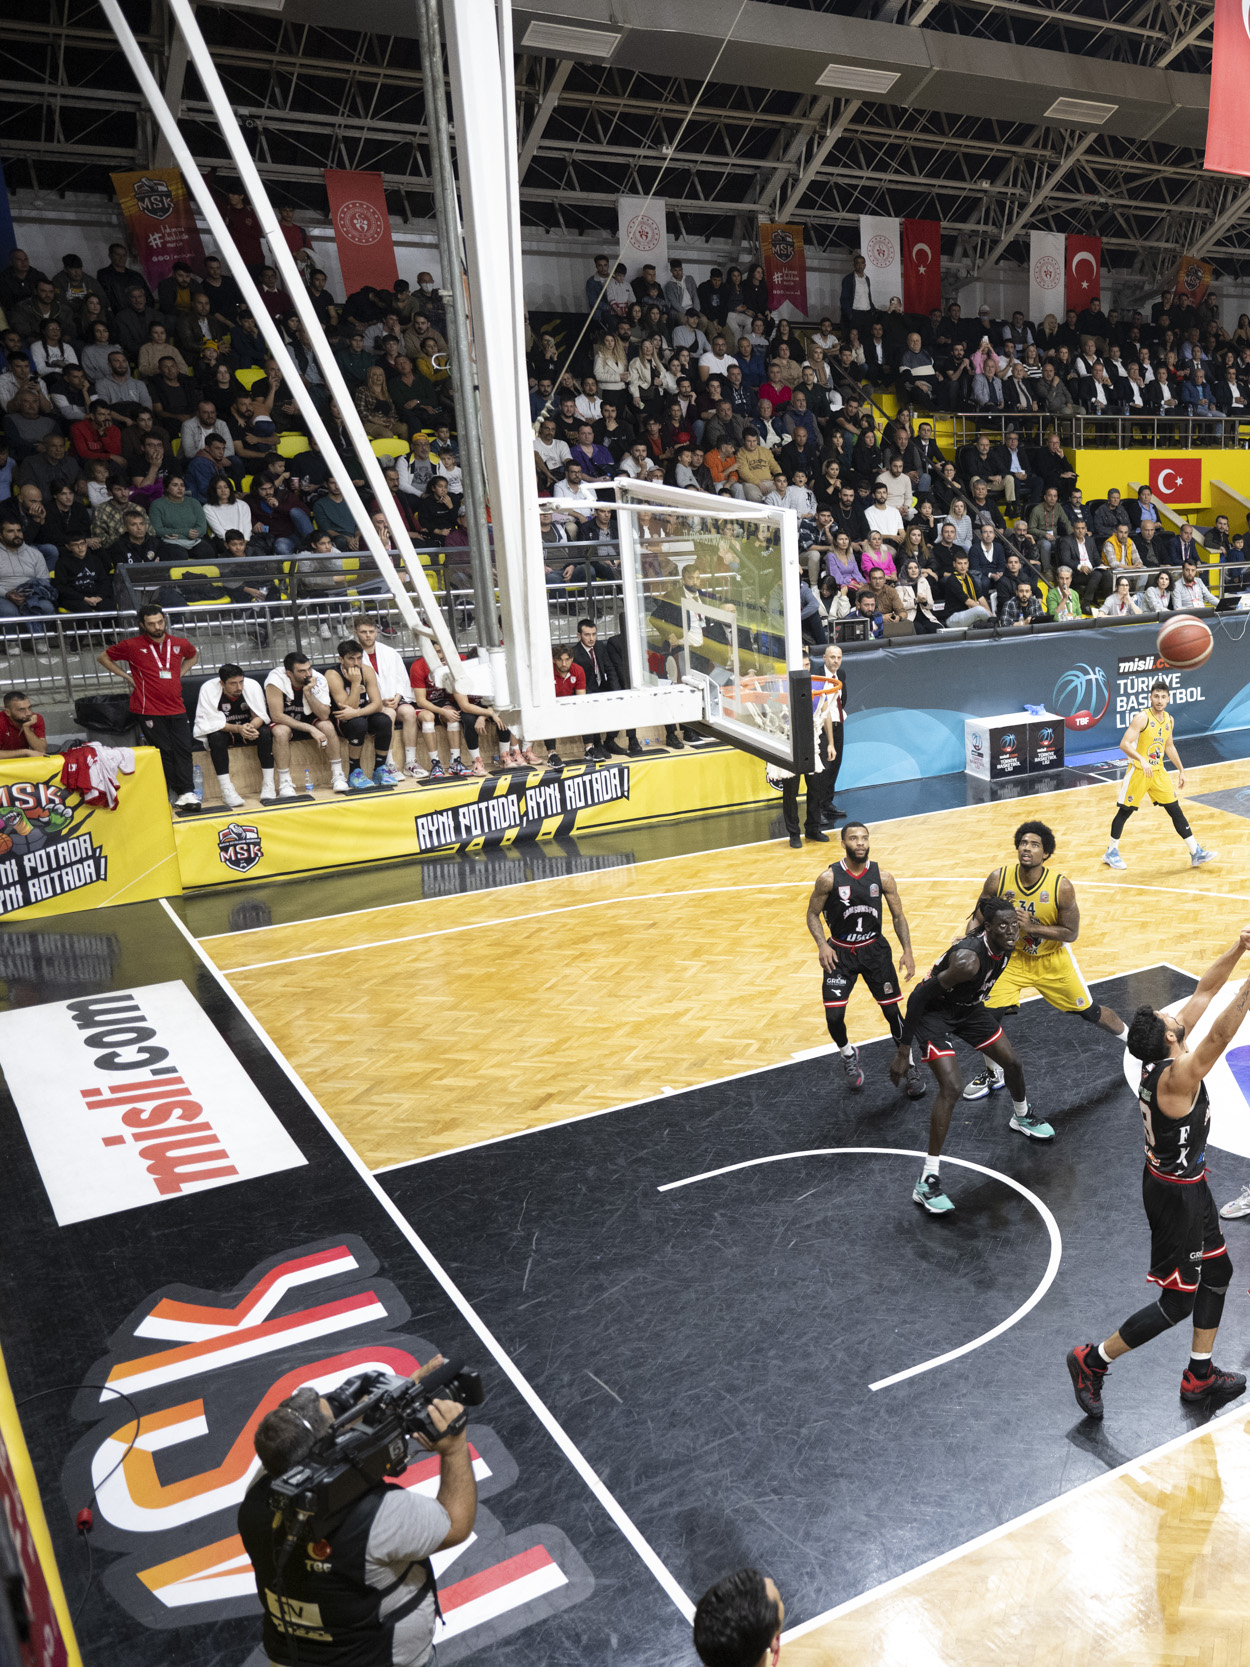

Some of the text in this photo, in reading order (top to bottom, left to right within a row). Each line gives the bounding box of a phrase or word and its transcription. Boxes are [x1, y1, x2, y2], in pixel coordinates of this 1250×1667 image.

[138, 195, 175, 211] MSK
[771, 246, 795, 256] MSK
[1117, 673, 1182, 695] TÜRKİYE
[1117, 687, 1205, 712] BASTBOL
[1075, 716, 1090, 726] TBF
[1158, 728, 1162, 737] 4
[417, 810, 456, 850] AYNI
[525, 783, 561, 821] AYNI
[220, 844, 264, 862] MSK
[843, 904, 878, 919] SAMSUNSPOR
[1019, 900, 1036, 916] 34
[855, 917, 863, 932] 1
[66, 994, 240, 1196] misli.com
[304, 1559, 332, 1573] TBF
